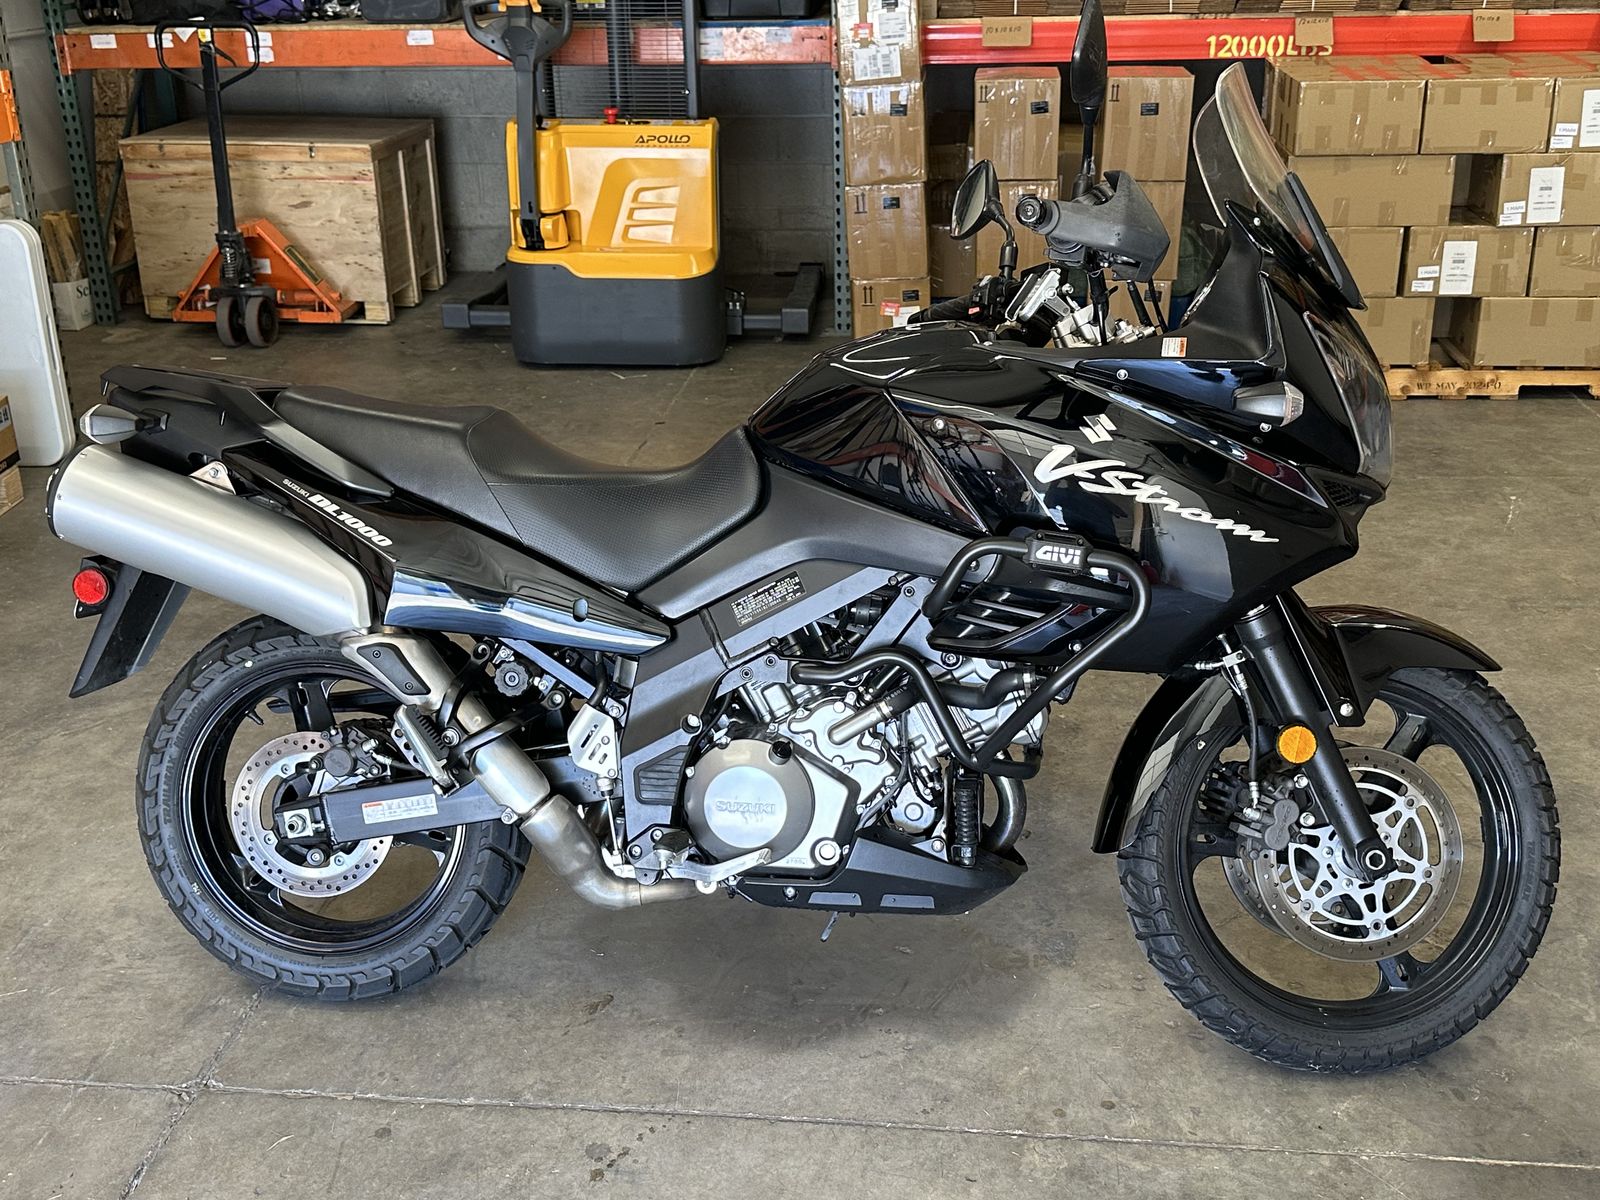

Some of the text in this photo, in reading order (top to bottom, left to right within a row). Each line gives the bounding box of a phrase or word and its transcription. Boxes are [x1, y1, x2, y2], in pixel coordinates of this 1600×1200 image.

[635, 134, 691, 144] APOLLO
[282, 478, 310, 498] SUZUKI
[307, 493, 393, 547] DL1000
[1035, 545, 1082, 565] GIVI
[716, 800, 776, 815] SUZUKI
